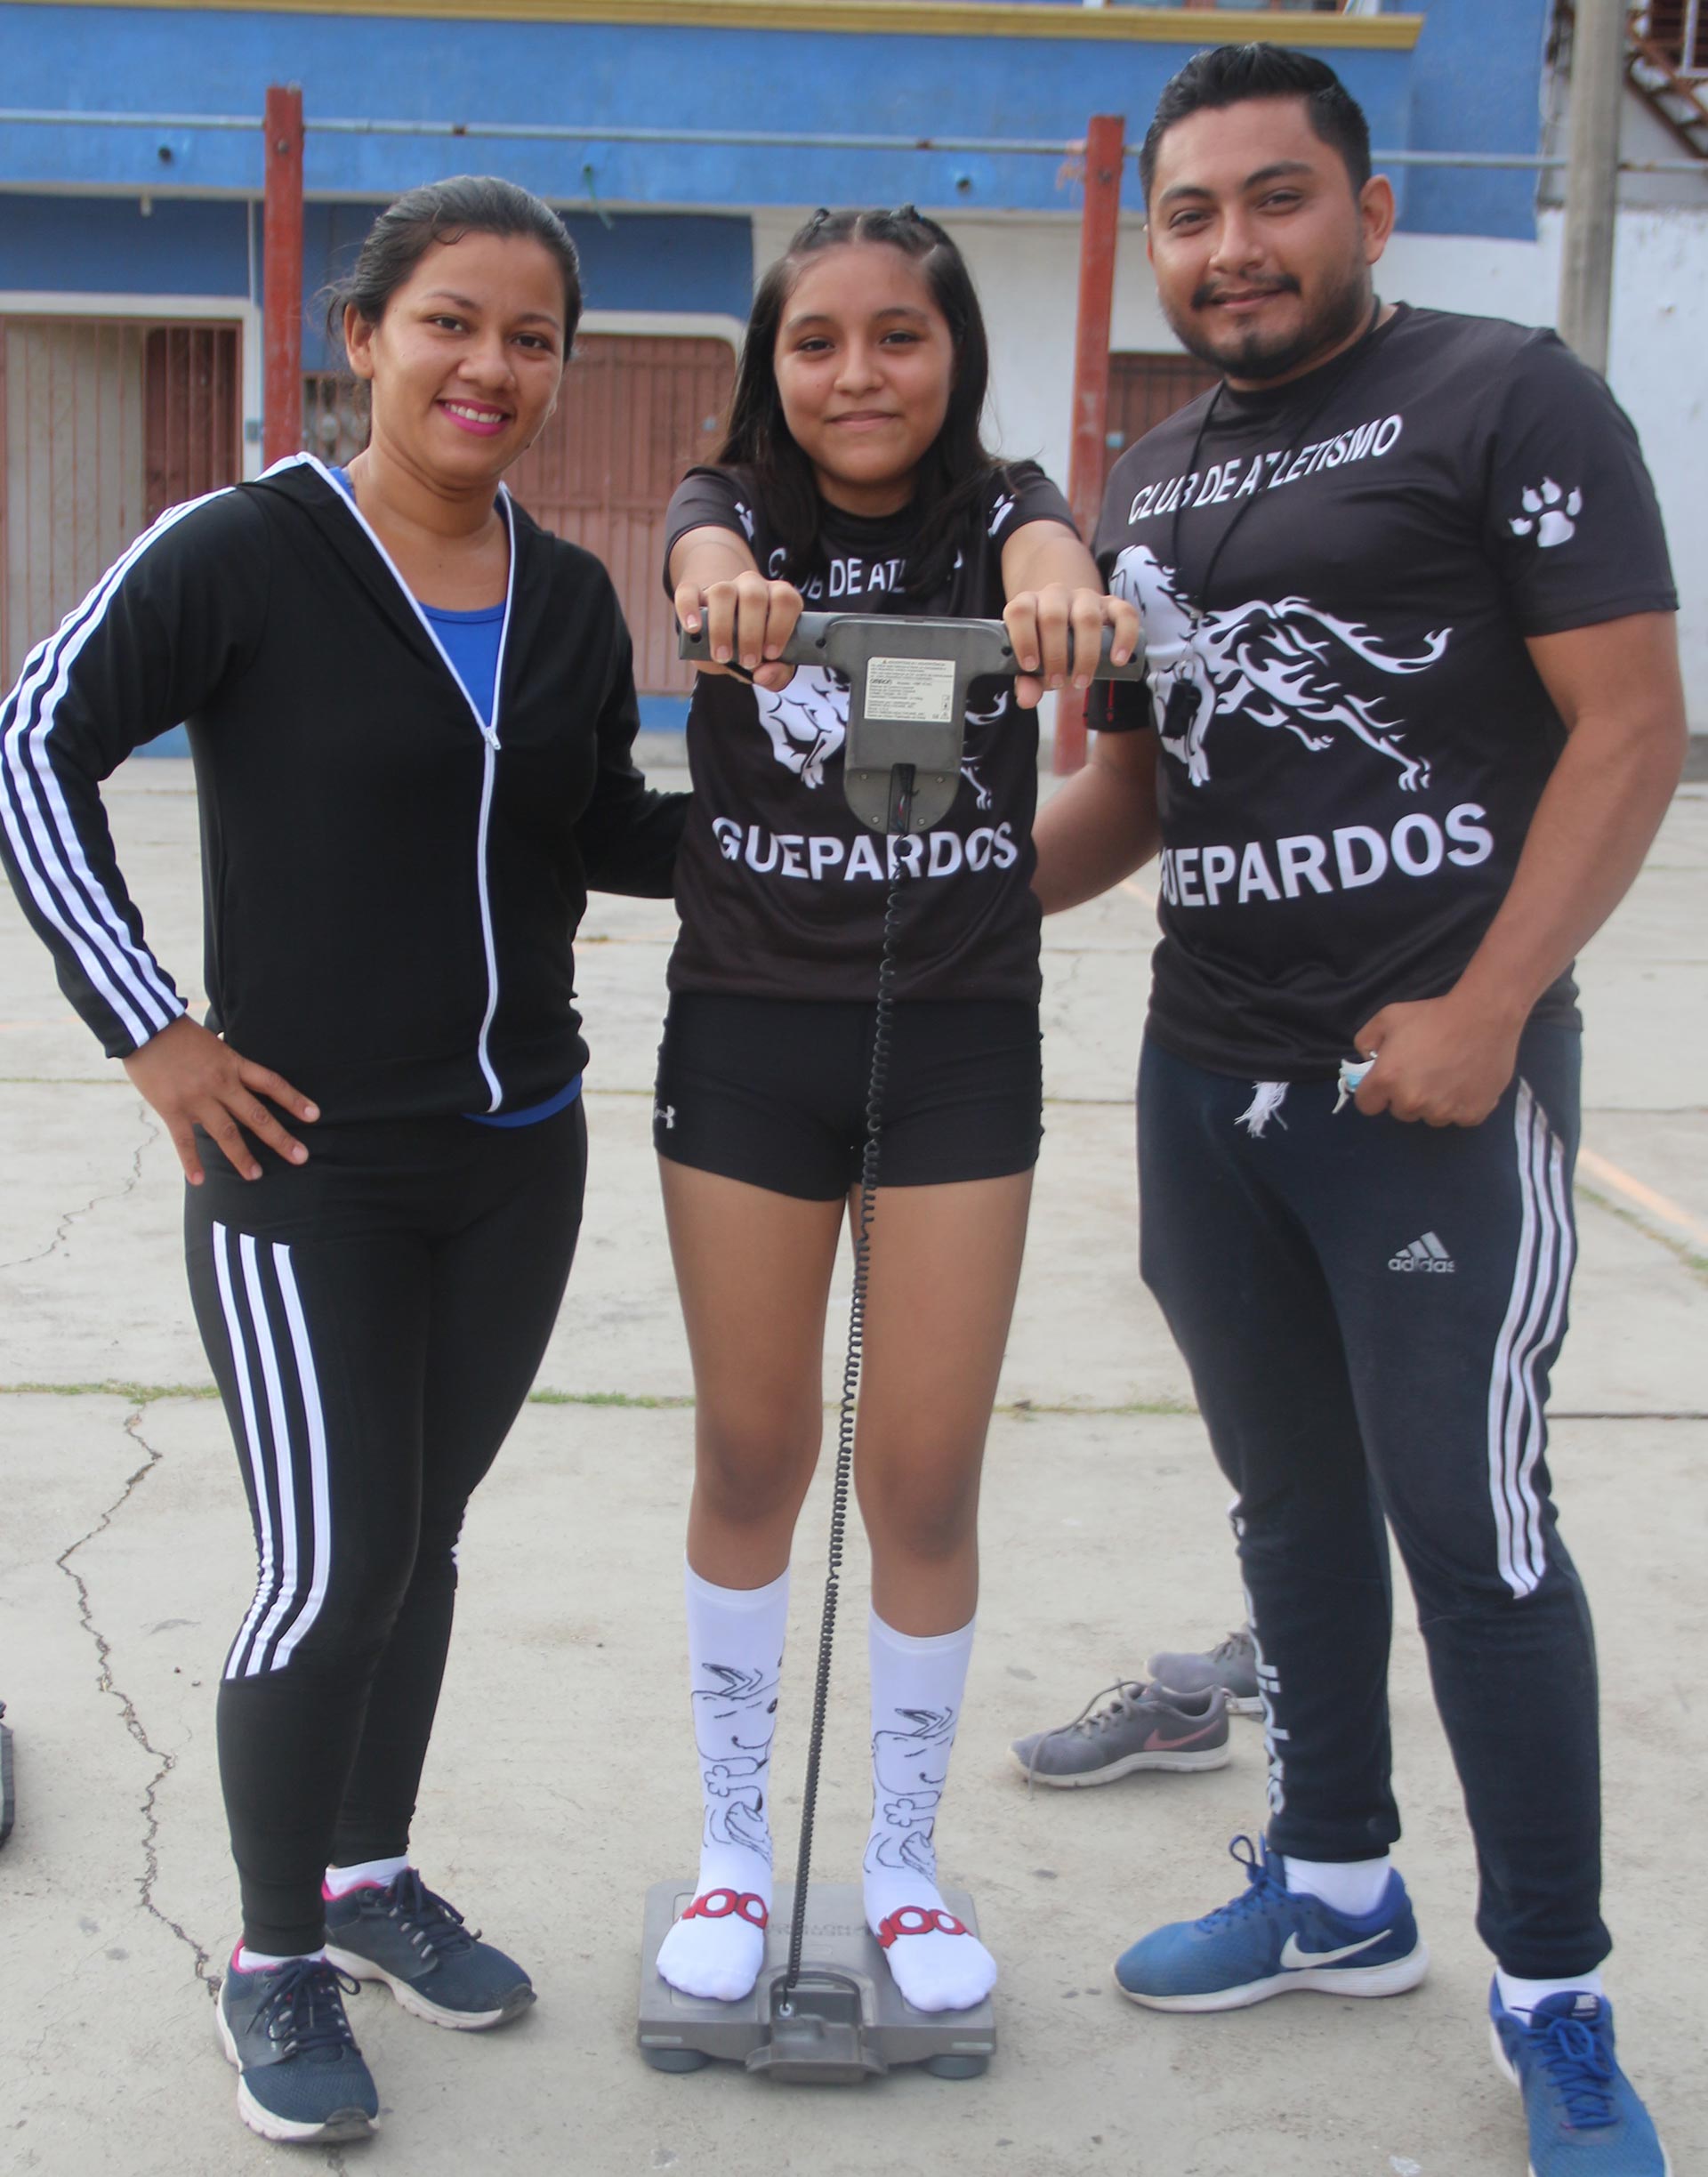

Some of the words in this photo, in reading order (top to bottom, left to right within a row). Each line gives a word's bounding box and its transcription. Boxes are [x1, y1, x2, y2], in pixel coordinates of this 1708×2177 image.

[1128, 472, 1199, 525] CLUB
[1192, 458, 1242, 508] DE
[828, 557, 863, 598] DE
[712, 816, 1019, 882] GUEPARDOS
[1388, 1257, 1455, 1273] addas
